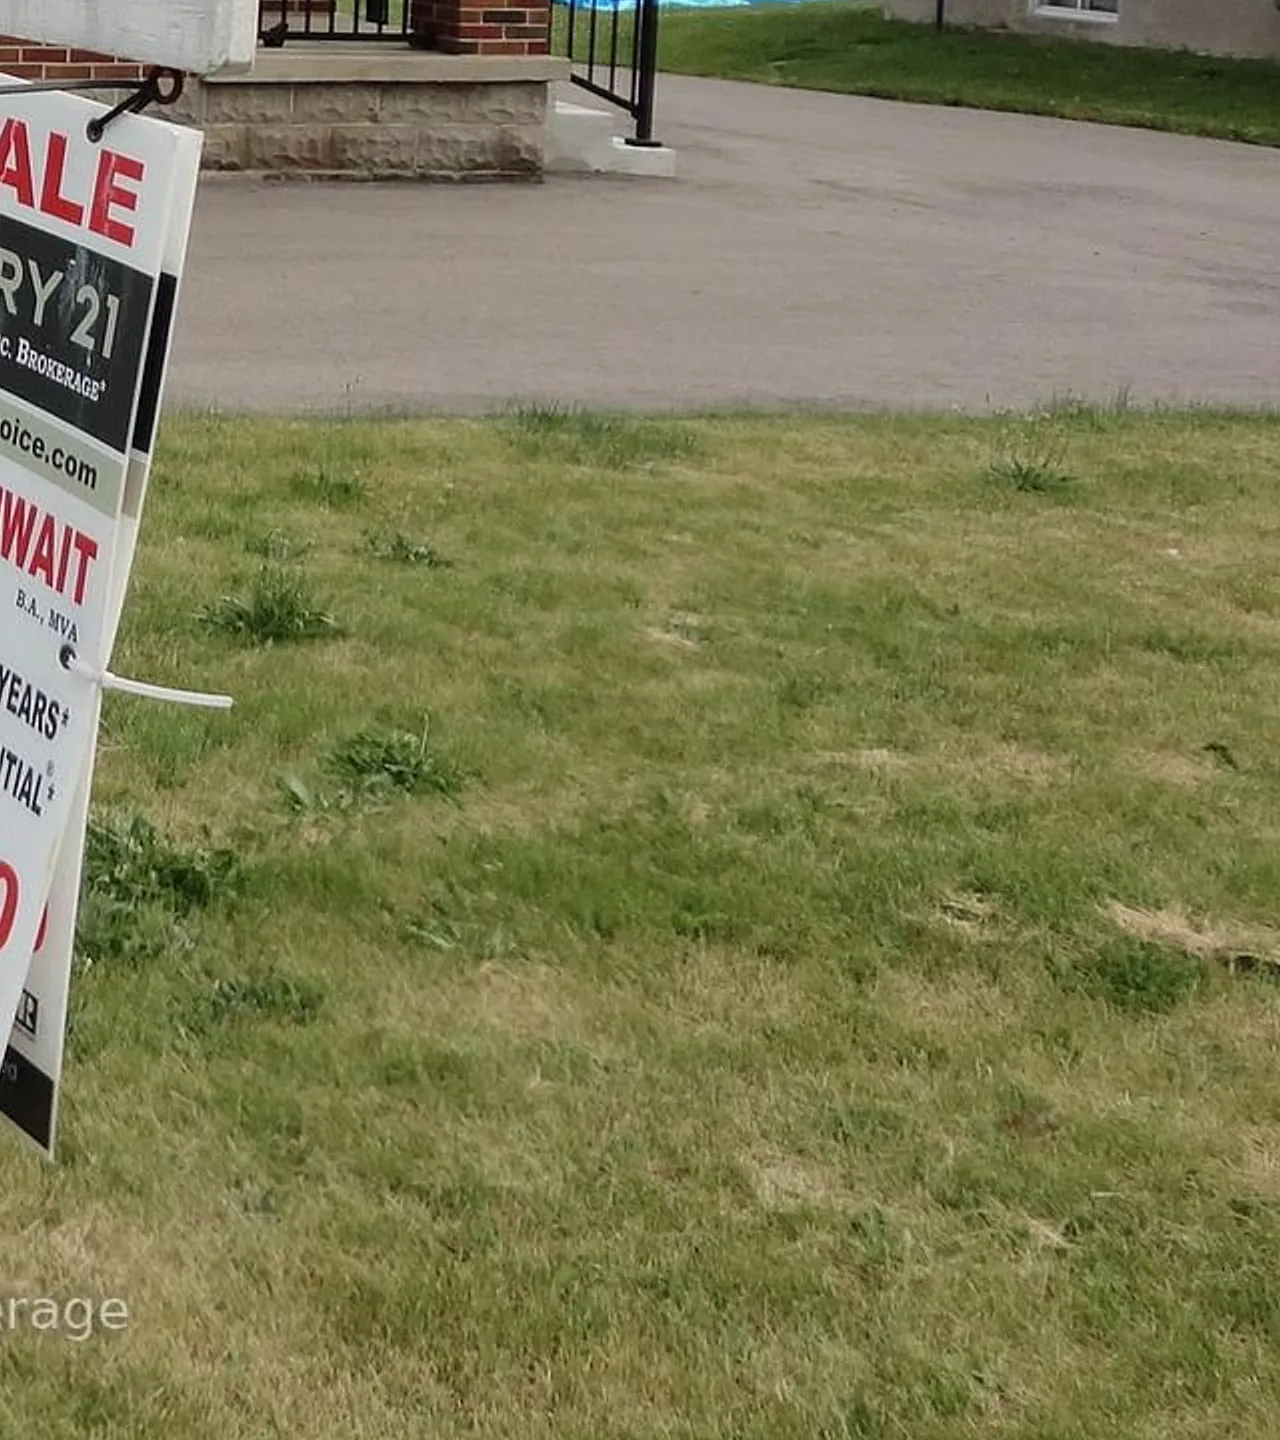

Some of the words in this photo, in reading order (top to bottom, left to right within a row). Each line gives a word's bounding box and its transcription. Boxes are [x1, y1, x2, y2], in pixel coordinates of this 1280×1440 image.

[70, 284, 120, 359] 21
[16, 589, 44, 625] B.A.,
[48, 609, 78, 643] MVA
